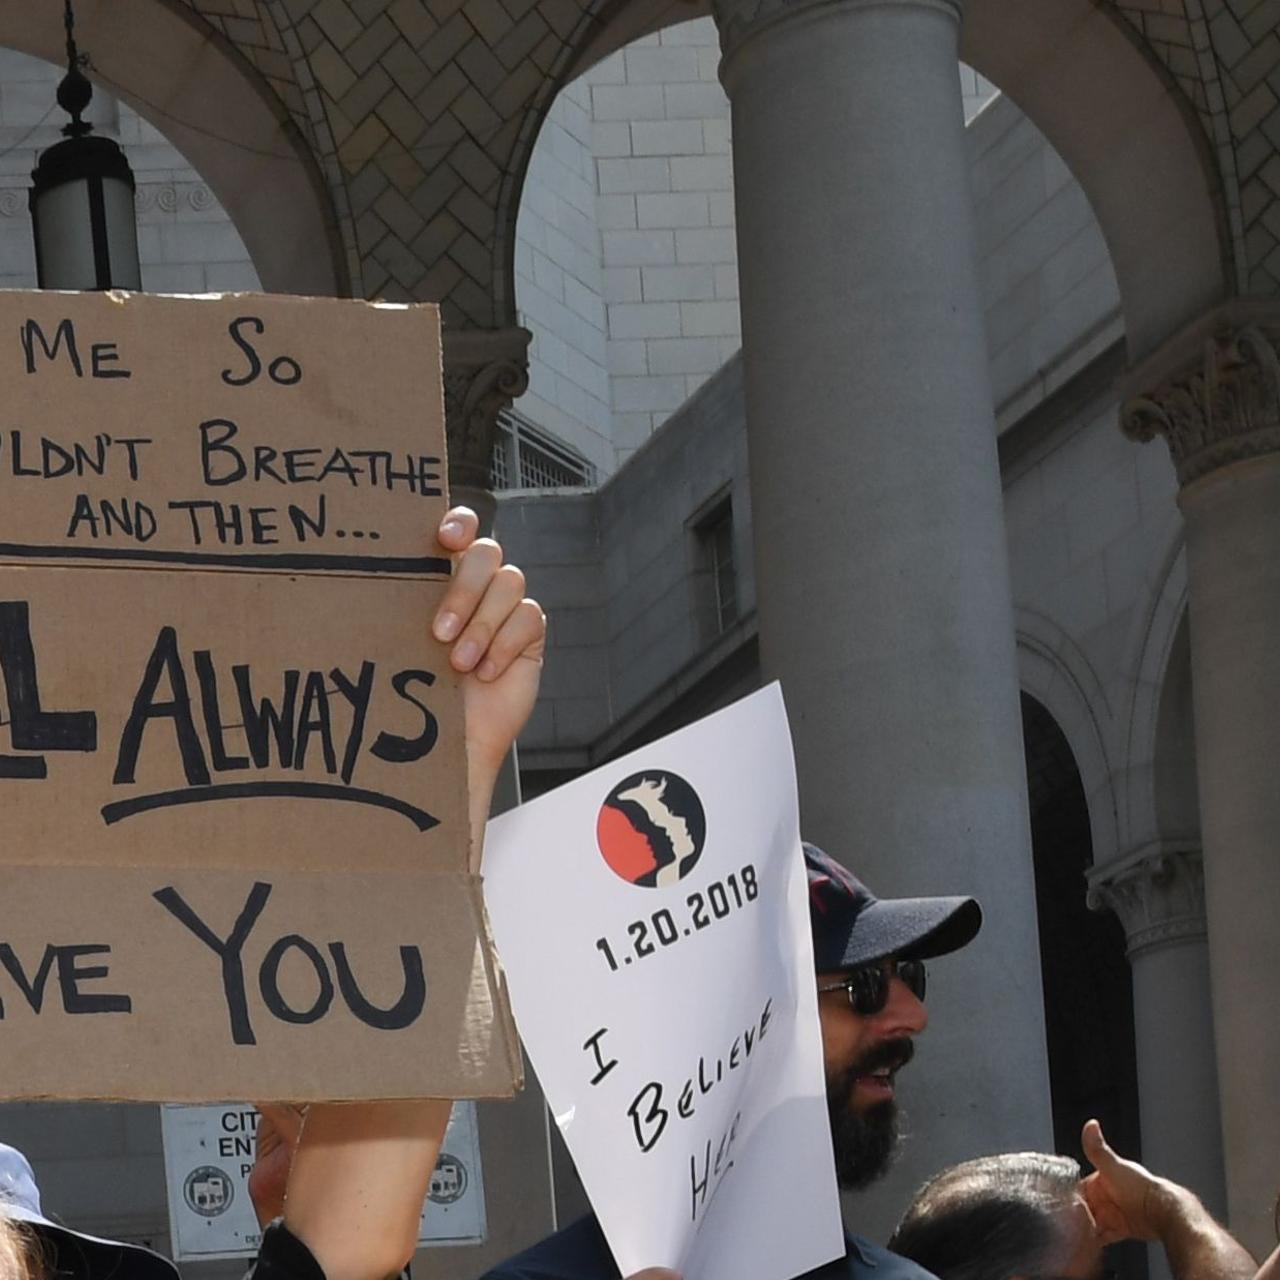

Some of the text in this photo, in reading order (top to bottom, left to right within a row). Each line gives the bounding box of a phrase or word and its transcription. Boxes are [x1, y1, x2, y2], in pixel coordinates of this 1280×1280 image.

[21, 319, 131, 378] ME
[200, 419, 442, 498] BREATHE
[67, 494, 379, 545] AND THEN...
[113, 626, 438, 786] ALWAYS
[597, 864, 758, 970] 1.20.2018
[153, 882, 425, 1045] YOU
[584, 1029, 617, 1085] I
